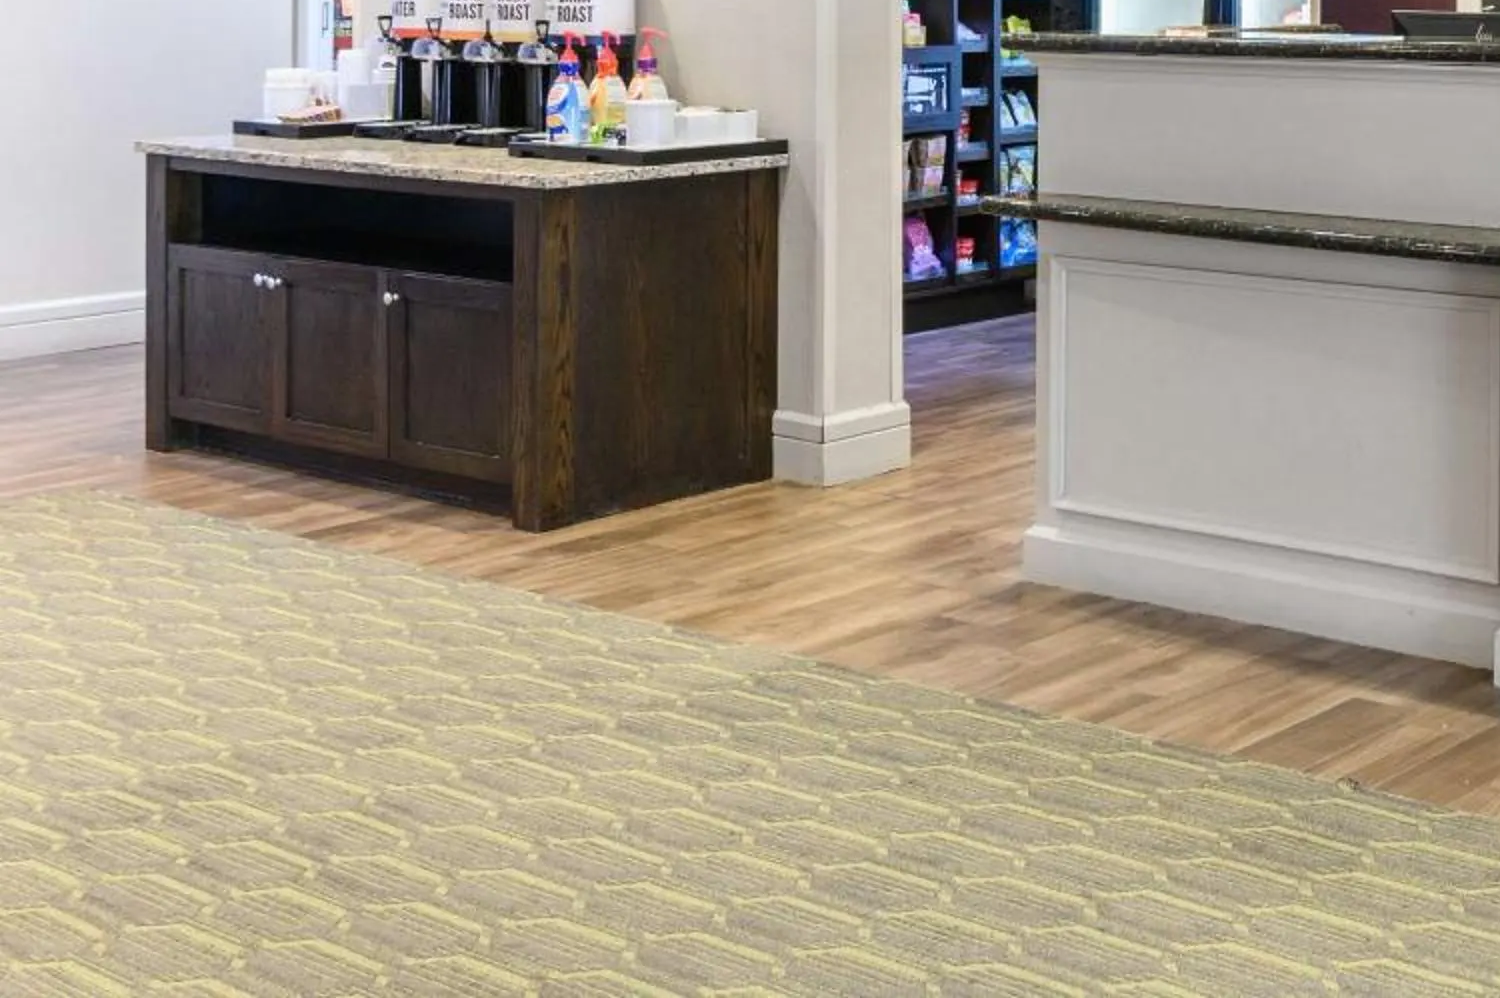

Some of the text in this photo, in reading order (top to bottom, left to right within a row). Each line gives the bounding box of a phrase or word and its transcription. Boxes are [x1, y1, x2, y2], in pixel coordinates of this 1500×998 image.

[448, 3, 485, 20] ROAST
[496, 4, 531, 21] ROAST
[557, 5, 594, 23] ROAST
